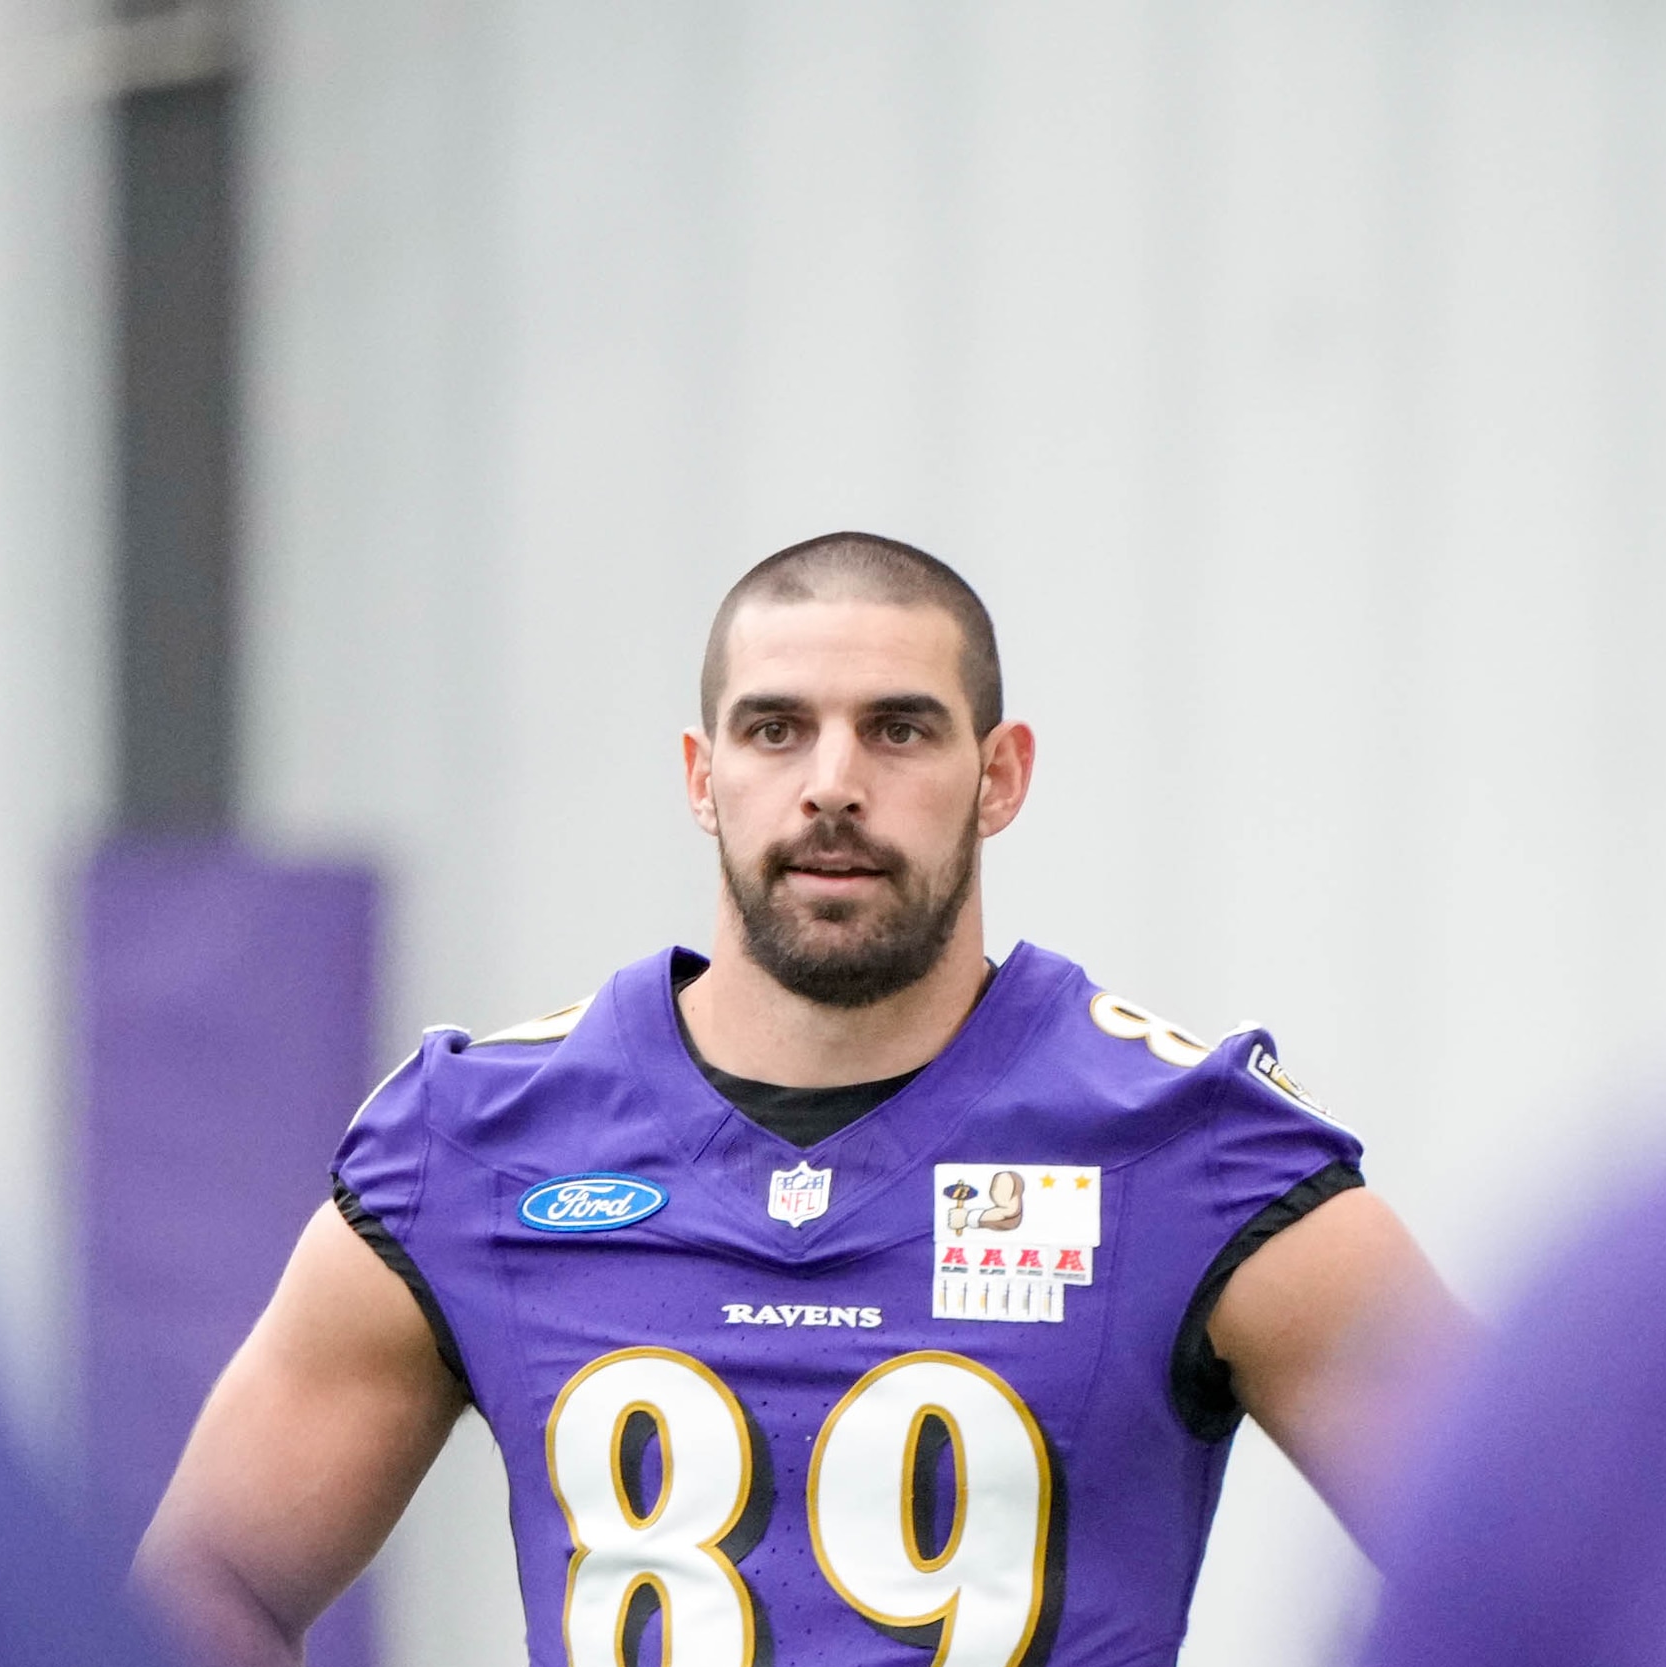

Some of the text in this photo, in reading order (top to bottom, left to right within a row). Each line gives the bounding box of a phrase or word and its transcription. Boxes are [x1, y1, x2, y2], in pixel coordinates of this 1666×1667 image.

[547, 1185, 635, 1220] Ford
[780, 1192, 815, 1213] NFL
[721, 1304, 882, 1328] RAVENS
